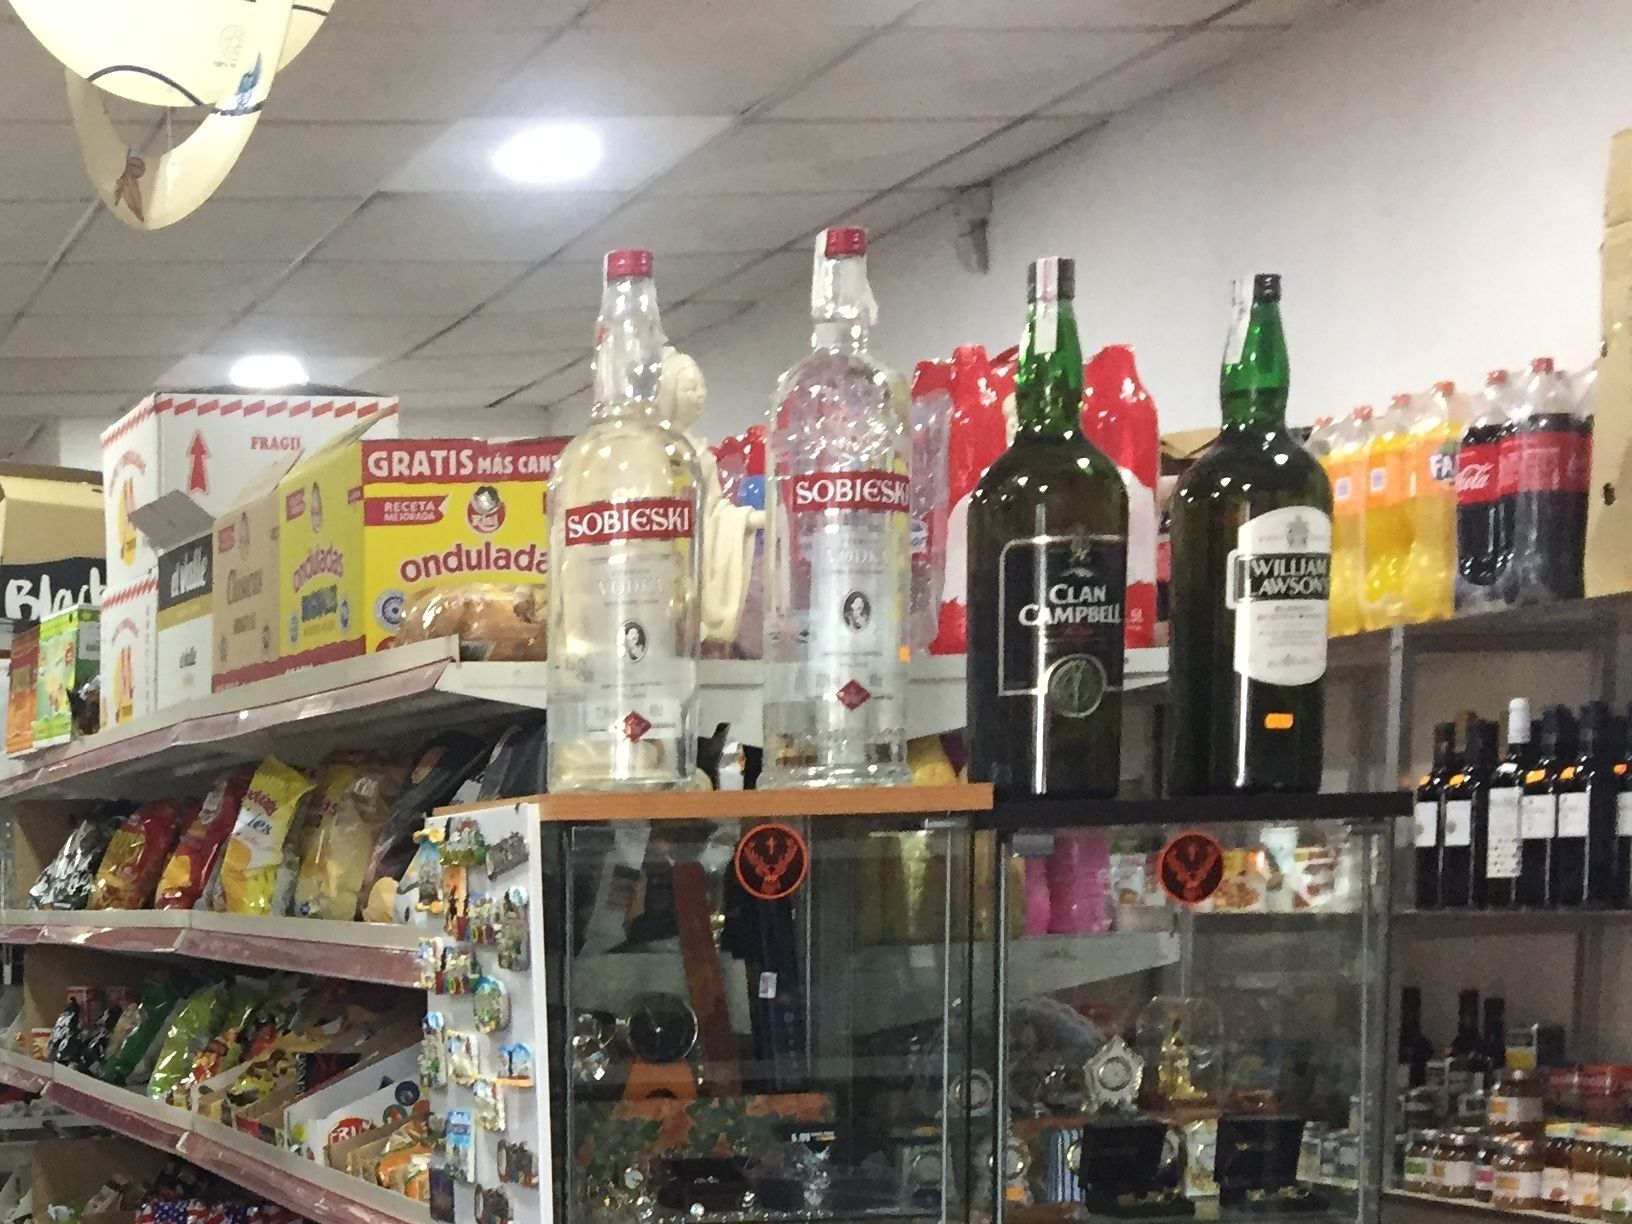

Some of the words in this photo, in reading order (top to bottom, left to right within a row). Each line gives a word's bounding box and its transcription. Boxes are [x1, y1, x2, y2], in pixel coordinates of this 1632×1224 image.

[367, 448, 473, 478] GRATIS
[477, 452, 513, 475] MÁS
[384, 500, 436, 513] RECETA
[567, 506, 690, 539] SOBIESKI
[1049, 583, 1107, 605] CLAN
[1018, 603, 1122, 626] CAMPBELL
